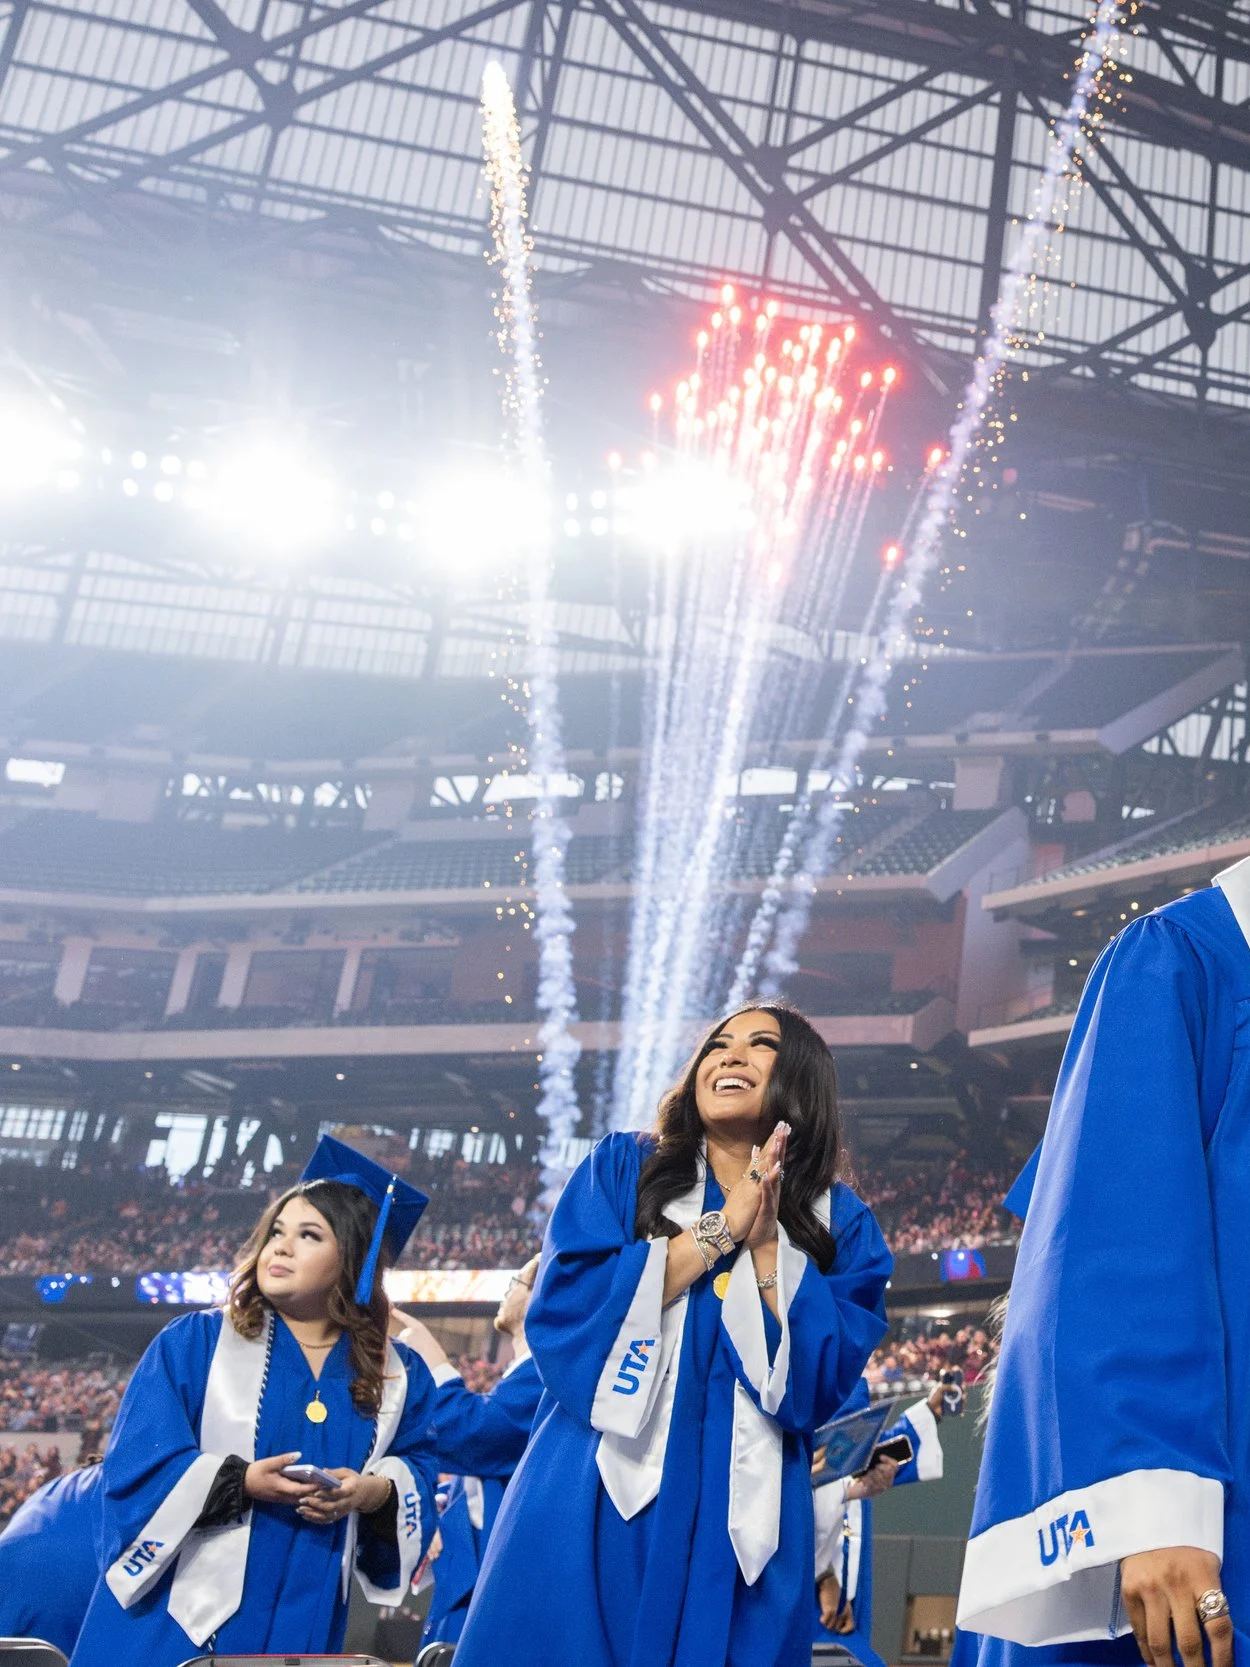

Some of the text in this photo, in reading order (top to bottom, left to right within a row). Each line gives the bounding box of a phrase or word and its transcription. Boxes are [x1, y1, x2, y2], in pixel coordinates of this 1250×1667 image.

[612, 1339, 655, 1395] UTA
[404, 1491, 417, 1538] UTA
[1038, 1509, 1095, 1566] UTA
[123, 1540, 164, 1577] UTA
